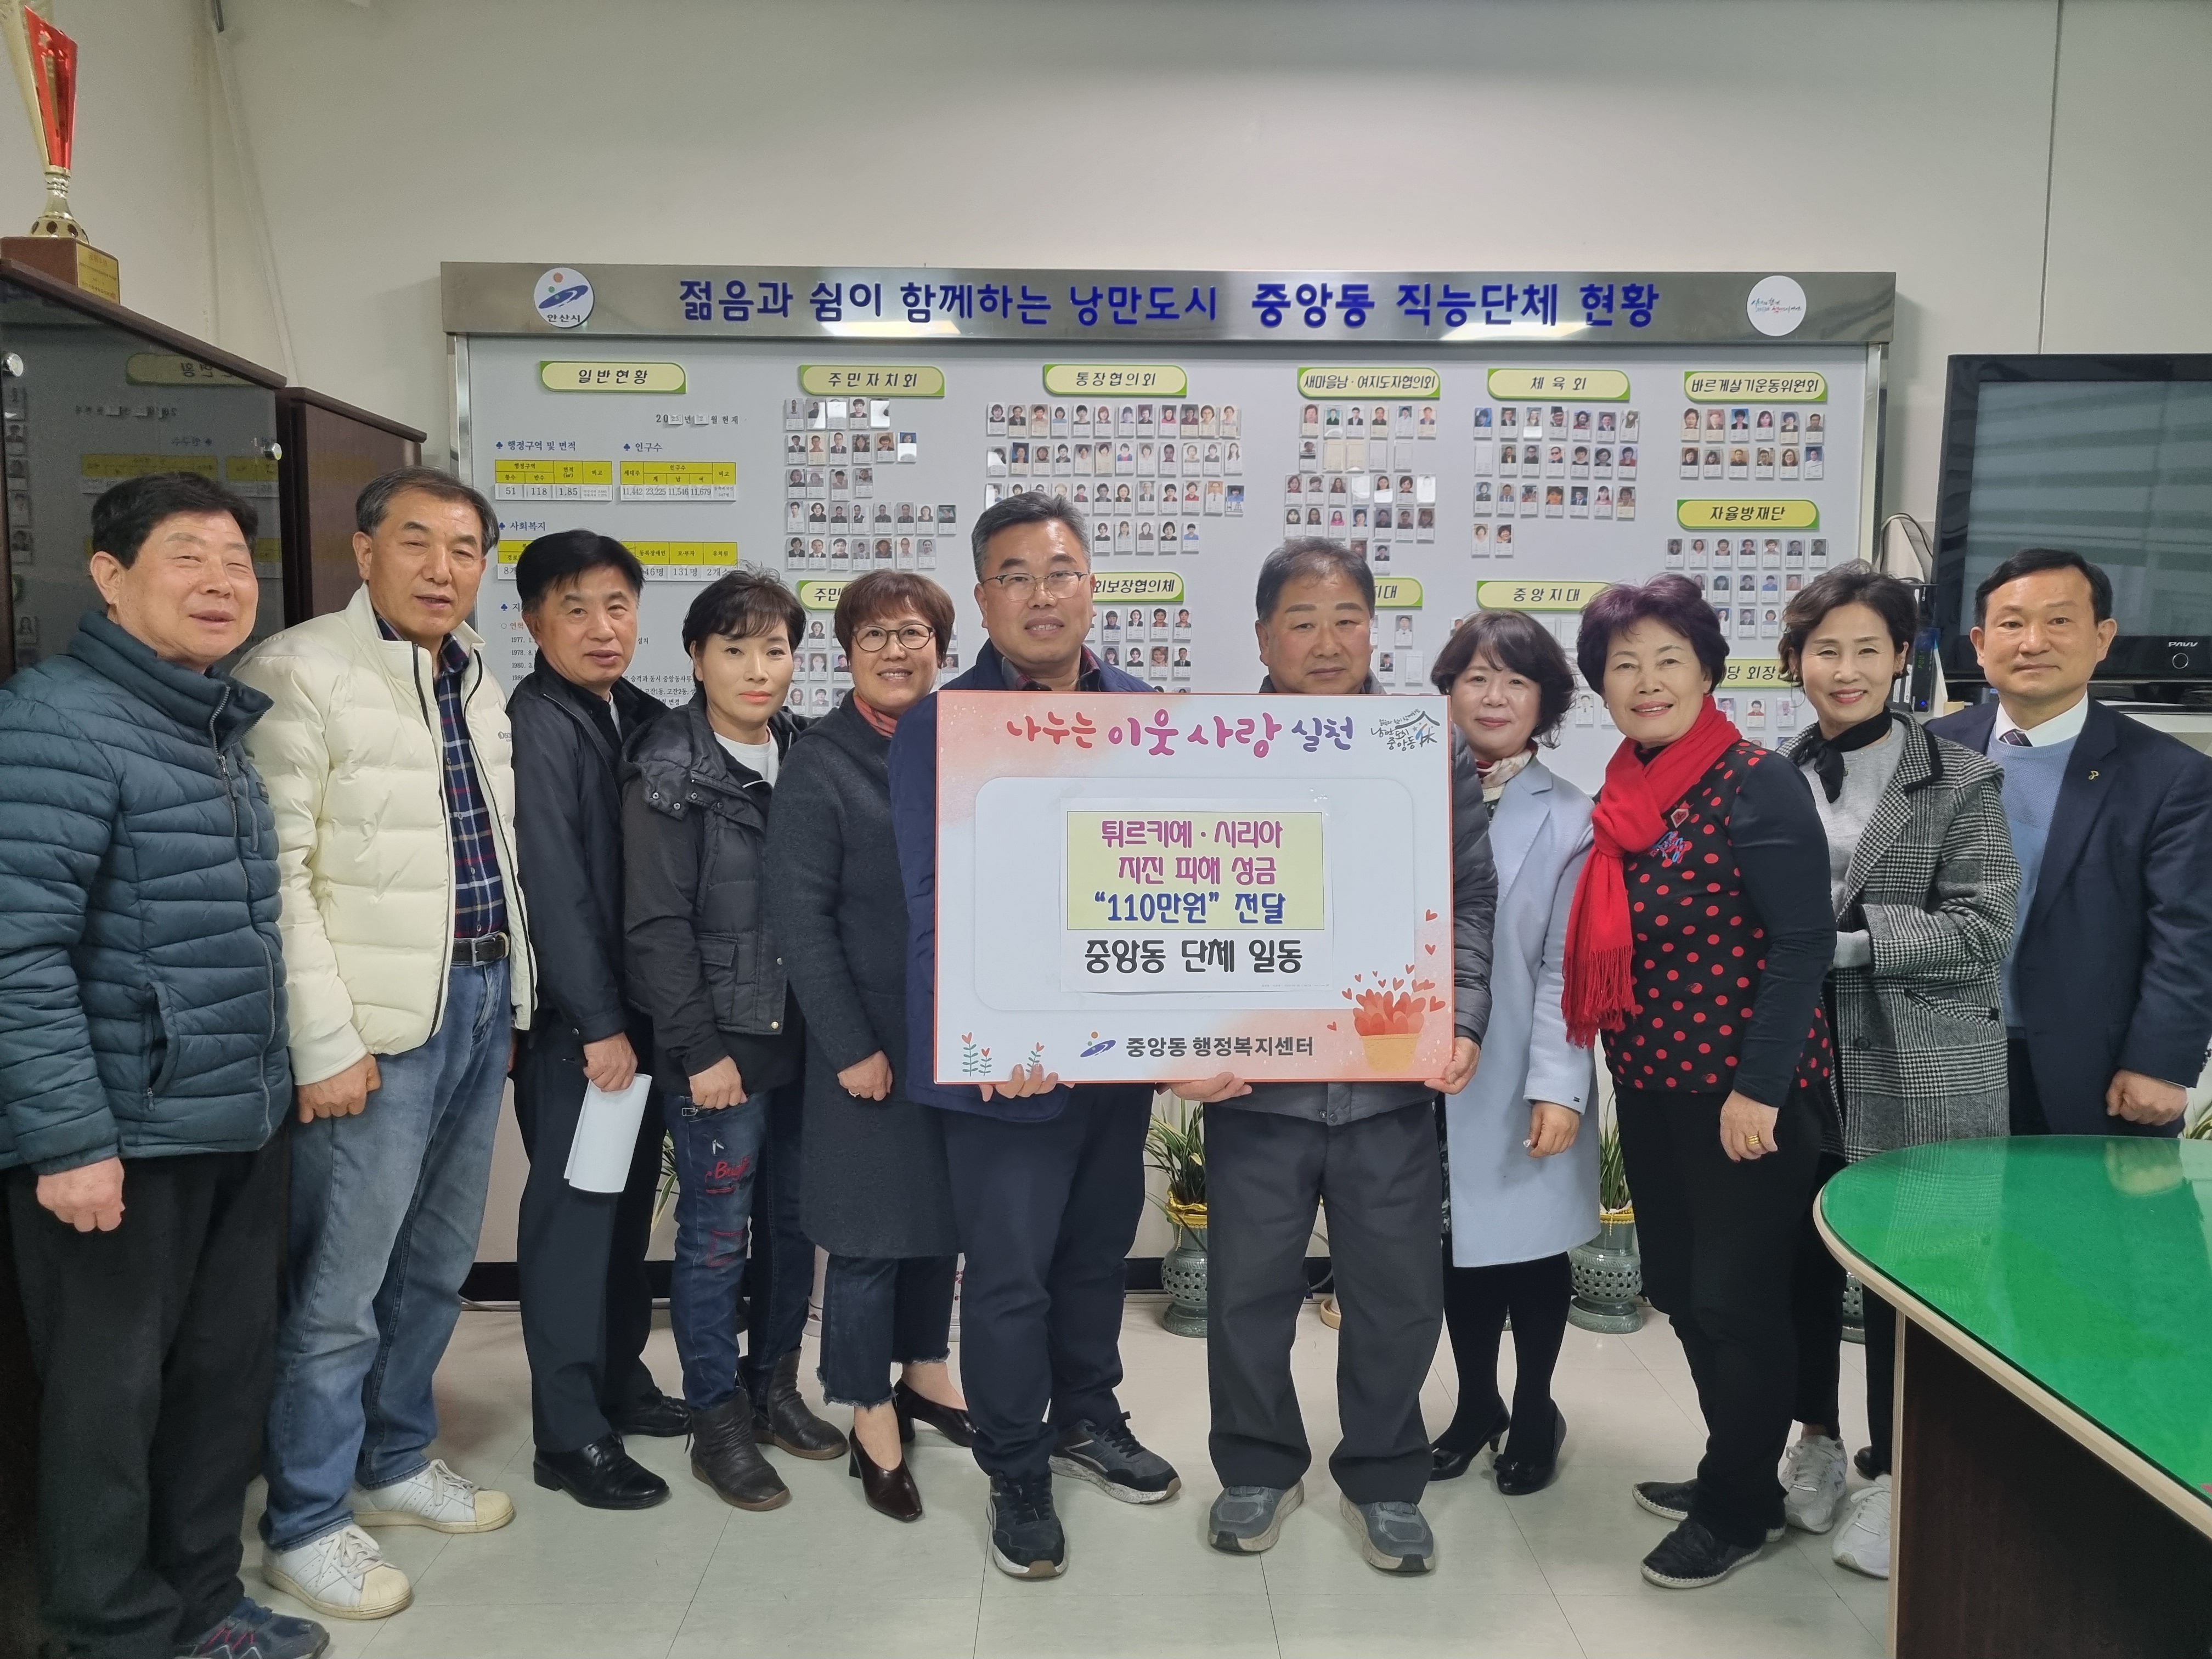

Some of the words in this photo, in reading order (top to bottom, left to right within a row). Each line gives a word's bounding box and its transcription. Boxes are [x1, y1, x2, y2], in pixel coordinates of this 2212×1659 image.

[680, 280, 794, 322] 젊음과
[809, 281, 882, 323] 쉼이
[900, 281, 1052, 325] 함께하는
[1070, 285, 1217, 327] 낭만도시
[1251, 283, 1375, 329] 중앙동
[1396, 283, 1558, 328] 직능단체
[1579, 283, 1660, 328] 현황
[547, 314, 580, 323] 안산시
[579, 369, 648, 384] 일반현황
[828, 372, 918, 387] 주민자치회
[1075, 372, 1156, 386] 통장협의회
[1691, 378, 1819, 393] 바르게살기운동위원회
[507, 441, 543, 451] 행정구역
[546, 441, 555, 451] 및
[559, 441, 576, 451] 면적
[635, 442, 662, 452] 인구수
[559, 488, 578, 496] 1.85
[646, 488, 666, 496] 23,225
[669, 488, 689, 496] 11,546
[691, 488, 712, 496] 11,679
[1709, 506, 1786, 521] 자율방재단
[510, 521, 545, 531] 사회복지
[674, 568, 697, 577] 131명
[1514, 588, 1580, 602] 중앙지대
[1007, 711, 1097, 749] 나누는
[1108, 709, 1179, 756] 이웃
[1187, 712, 1282, 758] 사랑
[1291, 716, 1353, 752] 실천
[1386, 736, 1416, 751] 중앙동
[1102, 820, 1192, 848] 튀르키예
[1214, 821, 1283, 849] 시리아
[1119, 856, 1164, 884] 지진
[1175, 856, 1221, 885] 피해
[1231, 857, 1277, 885] 성금
[1234, 893, 1286, 924] 전달
[1085, 939, 1166, 973] 중앙동
[1181, 938, 1235, 973] 단체
[1249, 939, 1303, 973] 일동
[1126, 1037, 1187, 1058] 중앙동
[1193, 1036, 1313, 1057] 행정복지센터
